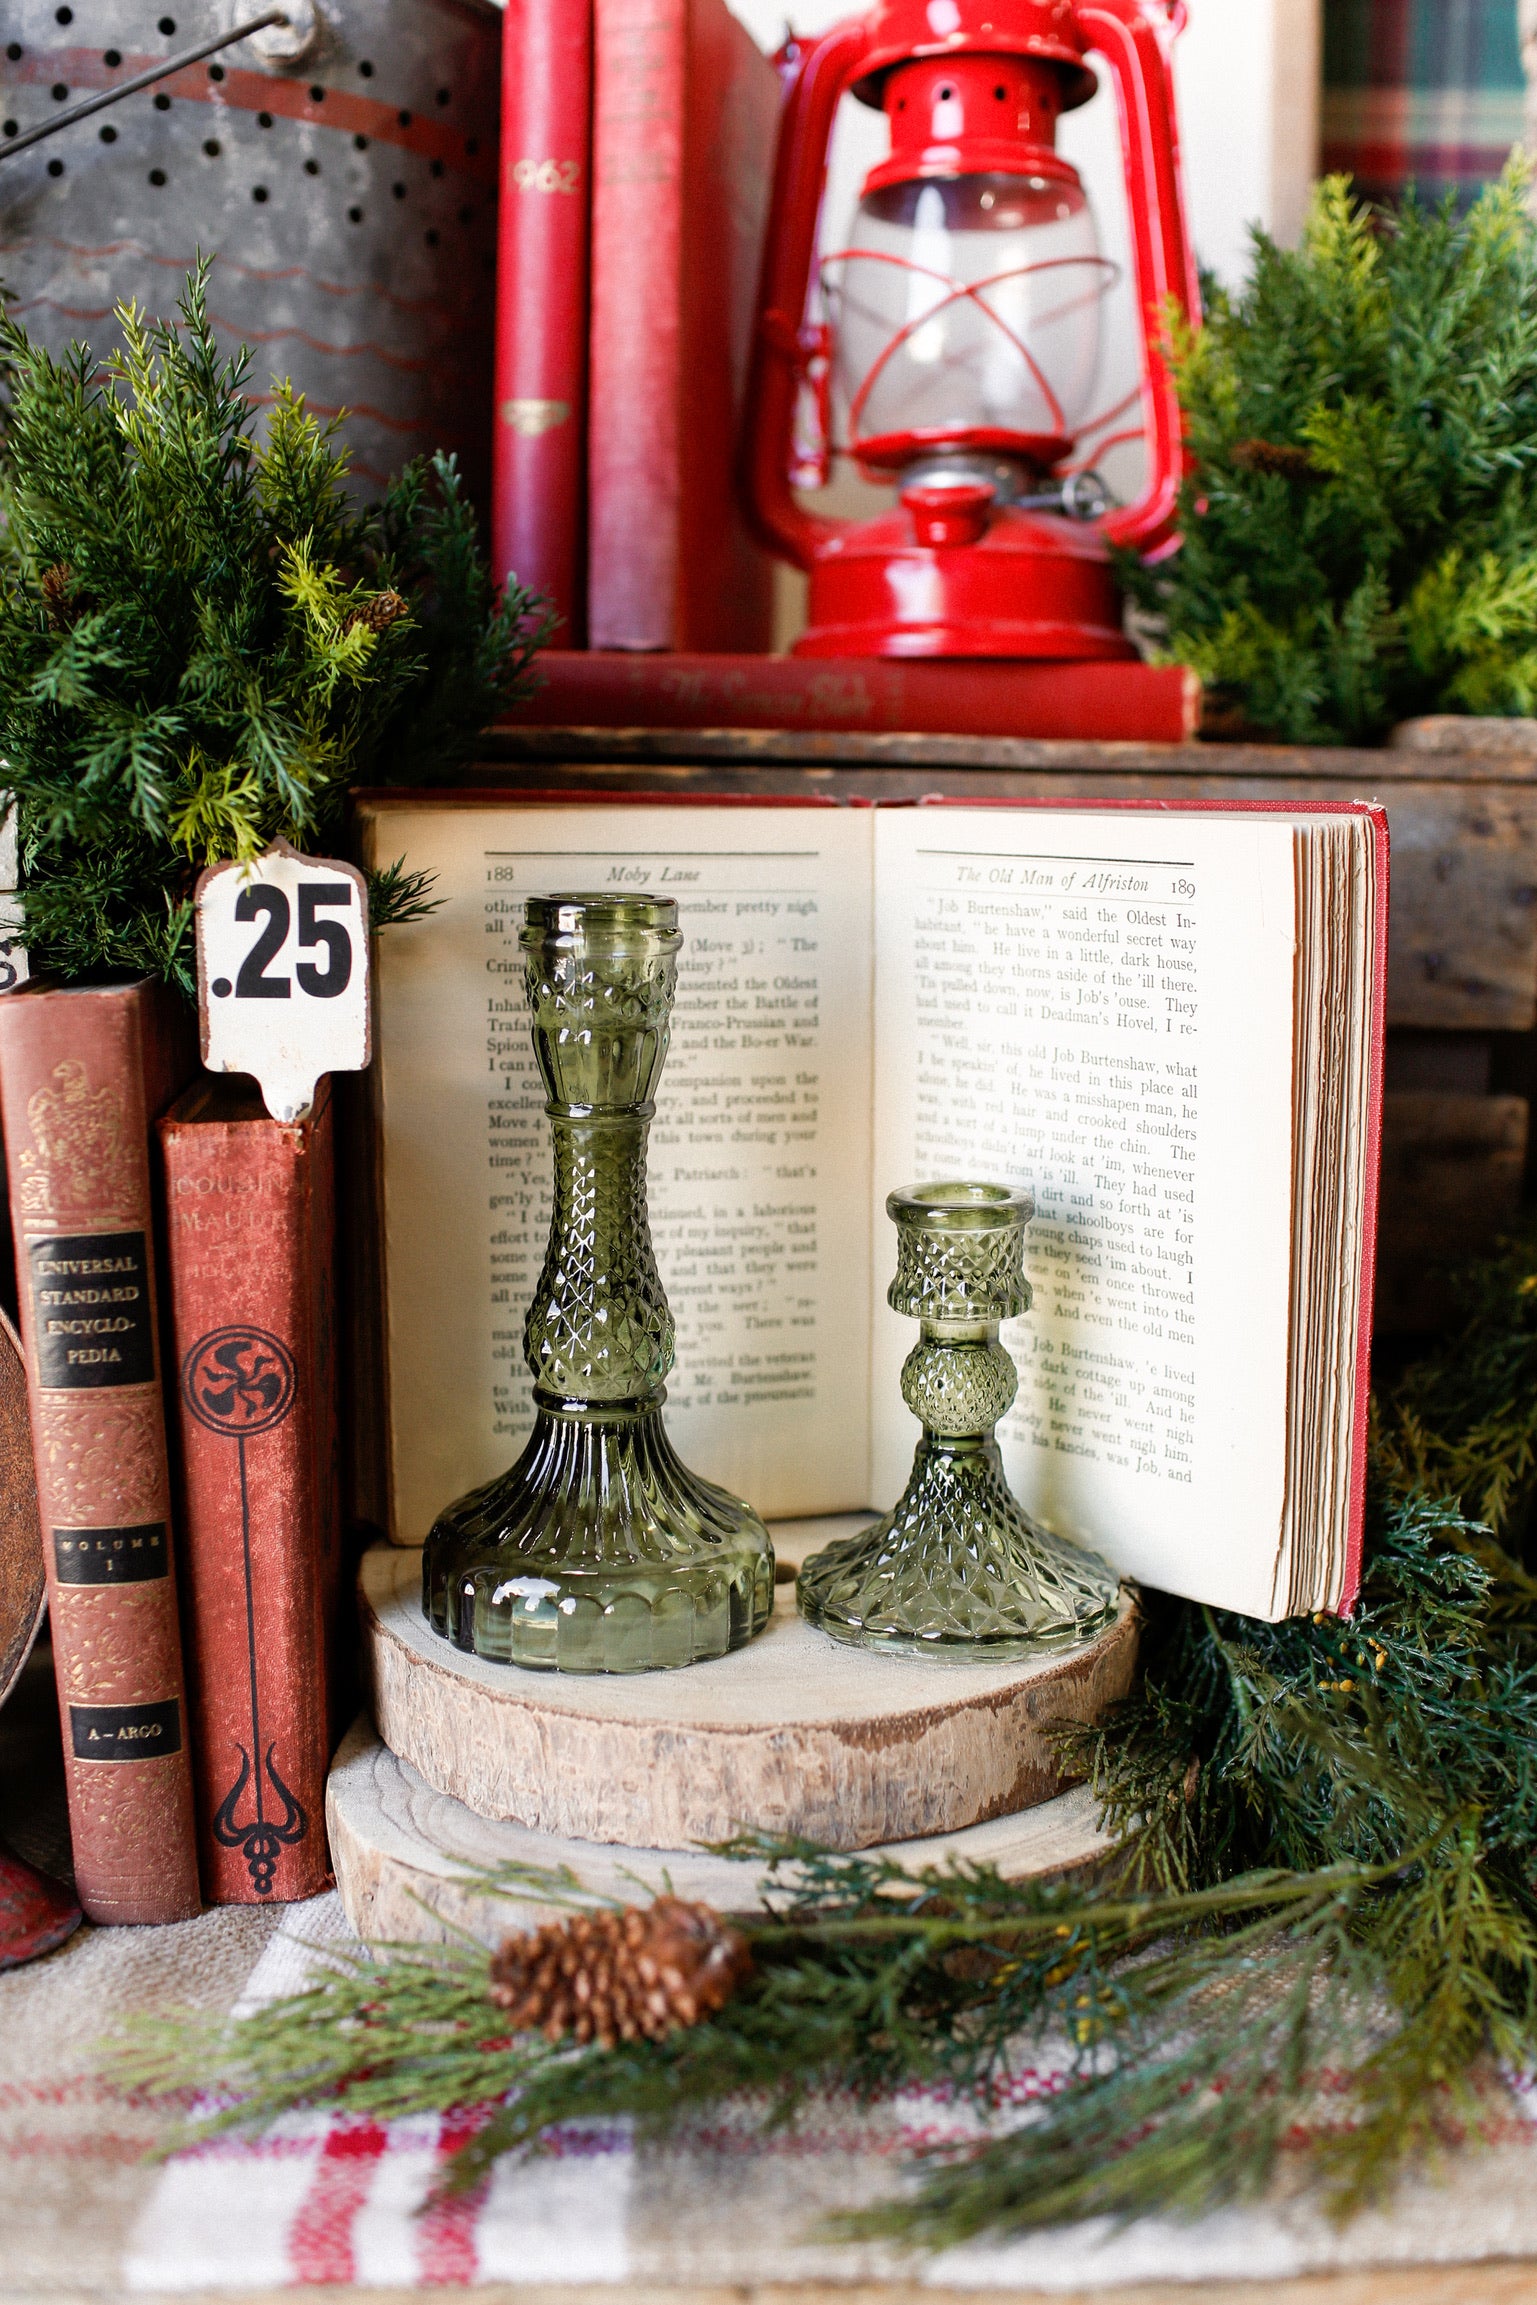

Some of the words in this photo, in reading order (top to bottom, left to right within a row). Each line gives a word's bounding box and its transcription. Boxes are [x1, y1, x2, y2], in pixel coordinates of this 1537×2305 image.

[486, 866, 514, 882] 188
[606, 866, 651, 885] Moby
[659, 866, 701, 881] Lane
[957, 865, 981, 882] The
[988, 868, 1014, 884] Old
[1020, 869, 1054, 886] Man
[1060, 871, 1078, 891] of
[1081, 873, 1149, 893] Alfriston
[1171, 878, 1196, 899] 189
[1062, 906, 1088, 921] said
[1096, 907, 1118, 923] the
[1126, 909, 1167, 927] Oldest
[1175, 912, 1197, 928] In-
[211, 883, 353, 999] .25
[1005, 922, 1036, 938] have
[1042, 927, 1051, 939] a
[1056, 928, 1120, 944] wonderful
[1126, 933, 1164, 948] secret
[1170, 937, 1197, 954] way
[993, 941, 1011, 956] He
[1017, 943, 1040, 958] live
[1046, 945, 1059, 960] in
[1065, 950, 1073, 961] a
[1079, 948, 1114, 966] little,
[1120, 951, 1151, 967] dark
[1157, 954, 1197, 974] house,
[1011, 963, 1051, 979] thorns
[1056, 968, 1088, 983] aside
[1093, 969, 1106, 984] of
[1112, 971, 1133, 986] the
[1161, 976, 1198, 993] there.
[1060, 986, 1071, 1001] is
[1076, 988, 1110, 1006] Job's
[1164, 996, 1198, 1018] They
[1023, 1003, 1033, 1018] it
[1040, 1004, 1110, 1026] Deadman's
[1116, 1012, 1158, 1034] Hovel,
[1166, 1018, 1172, 1033] I
[1179, 1022, 1198, 1035] re-
[1052, 1047, 1075, 1065] Job
[1080, 1050, 1160, 1075] Burtenshaw,
[1165, 1061, 1198, 1078] what
[1029, 1063, 1044, 1078] he
[1050, 1066, 1081, 1084] lived
[1088, 1071, 1101, 1086] in
[1109, 1074, 1133, 1090] this
[1140, 1078, 1174, 1096] place
[1181, 1084, 1198, 1099] all
[1011, 1081, 1029, 1097] He
[1034, 1088, 1057, 1101] was
[1063, 1092, 1070, 1102] a
[1075, 1091, 1140, 1113] misshapen
[1144, 1102, 1177, 1119] man,
[1182, 1104, 1198, 1120] he
[1045, 1109, 1069, 1122] and
[1077, 1113, 1127, 1131] crooked
[1135, 1119, 1197, 1141] shoulders
[1051, 1129, 1087, 1145] under
[1093, 1134, 1114, 1149] the
[1119, 1138, 1151, 1155] chin.
[1170, 1144, 1196, 1161] The
[1050, 1147, 1075, 1164] look
[1081, 1154, 1094, 1168] at
[1132, 1161, 1195, 1182] whenever
[1041, 1187, 1064, 1202] dirt
[1069, 1193, 1094, 1207] and
[1099, 1199, 1114, 1211] so
[1119, 1199, 1151, 1217] forth
[1157, 1207, 1172, 1220] at
[1093, 1174, 1126, 1196] They
[1132, 1180, 1157, 1197] had
[1164, 1188, 1195, 1204] used
[1065, 1210, 1135, 1236] schoolboys
[1143, 1226, 1165, 1239] are
[1174, 1228, 1194, 1244] for
[1027, 1225, 1065, 1245] young
[1067, 1229, 1103, 1250] chaps
[1107, 1240, 1136, 1254] used
[1139, 1243, 1153, 1257] to
[1156, 1245, 1194, 1267] laugh
[37, 1256, 139, 1276] UNIVERSAL
[1044, 1244, 1071, 1264] they
[1074, 1251, 1102, 1267] seed
[1130, 1262, 1172, 1281] about.
[1187, 1271, 1193, 1284] I
[39, 1286, 140, 1305] STANDARD
[1053, 1286, 1086, 1302] when
[1107, 1296, 1138, 1312] went
[1142, 1300, 1169, 1319] into
[1174, 1308, 1196, 1325] the
[1105, 1278, 1135, 1292] once
[1141, 1283, 1195, 1305] throwed
[47, 1316, 137, 1335] ENCYCLO-
[1054, 1303, 1080, 1320] And
[1083, 1312, 1113, 1327] even
[1117, 1316, 1139, 1332] the
[1142, 1321, 1162, 1338] old
[1167, 1329, 1195, 1345] men
[67, 1348, 122, 1364] PEDIA
[1032, 1335, 1055, 1353] Job
[1060, 1341, 1139, 1373] Burtenshaw,
[1164, 1364, 1195, 1385] lived
[1040, 1357, 1069, 1376] dark
[1074, 1368, 1122, 1389] cottage
[1129, 1380, 1146, 1396] up
[1152, 1384, 1196, 1408] among
[1048, 1396, 1067, 1414] He
[1077, 1407, 1112, 1423] never
[1123, 1416, 1155, 1433] went
[1165, 1426, 1194, 1445] nigh
[1083, 1386, 1104, 1401] the
[1145, 1400, 1172, 1419] And
[1180, 1407, 1196, 1424] he
[1049, 1419, 1083, 1436] never
[1091, 1429, 1122, 1445] went
[1129, 1438, 1157, 1456] nigh
[1164, 1443, 1193, 1464] him.
[1106, 1451, 1130, 1466] was
[1135, 1456, 1162, 1478] Job,
[1167, 1468, 1193, 1484] and
